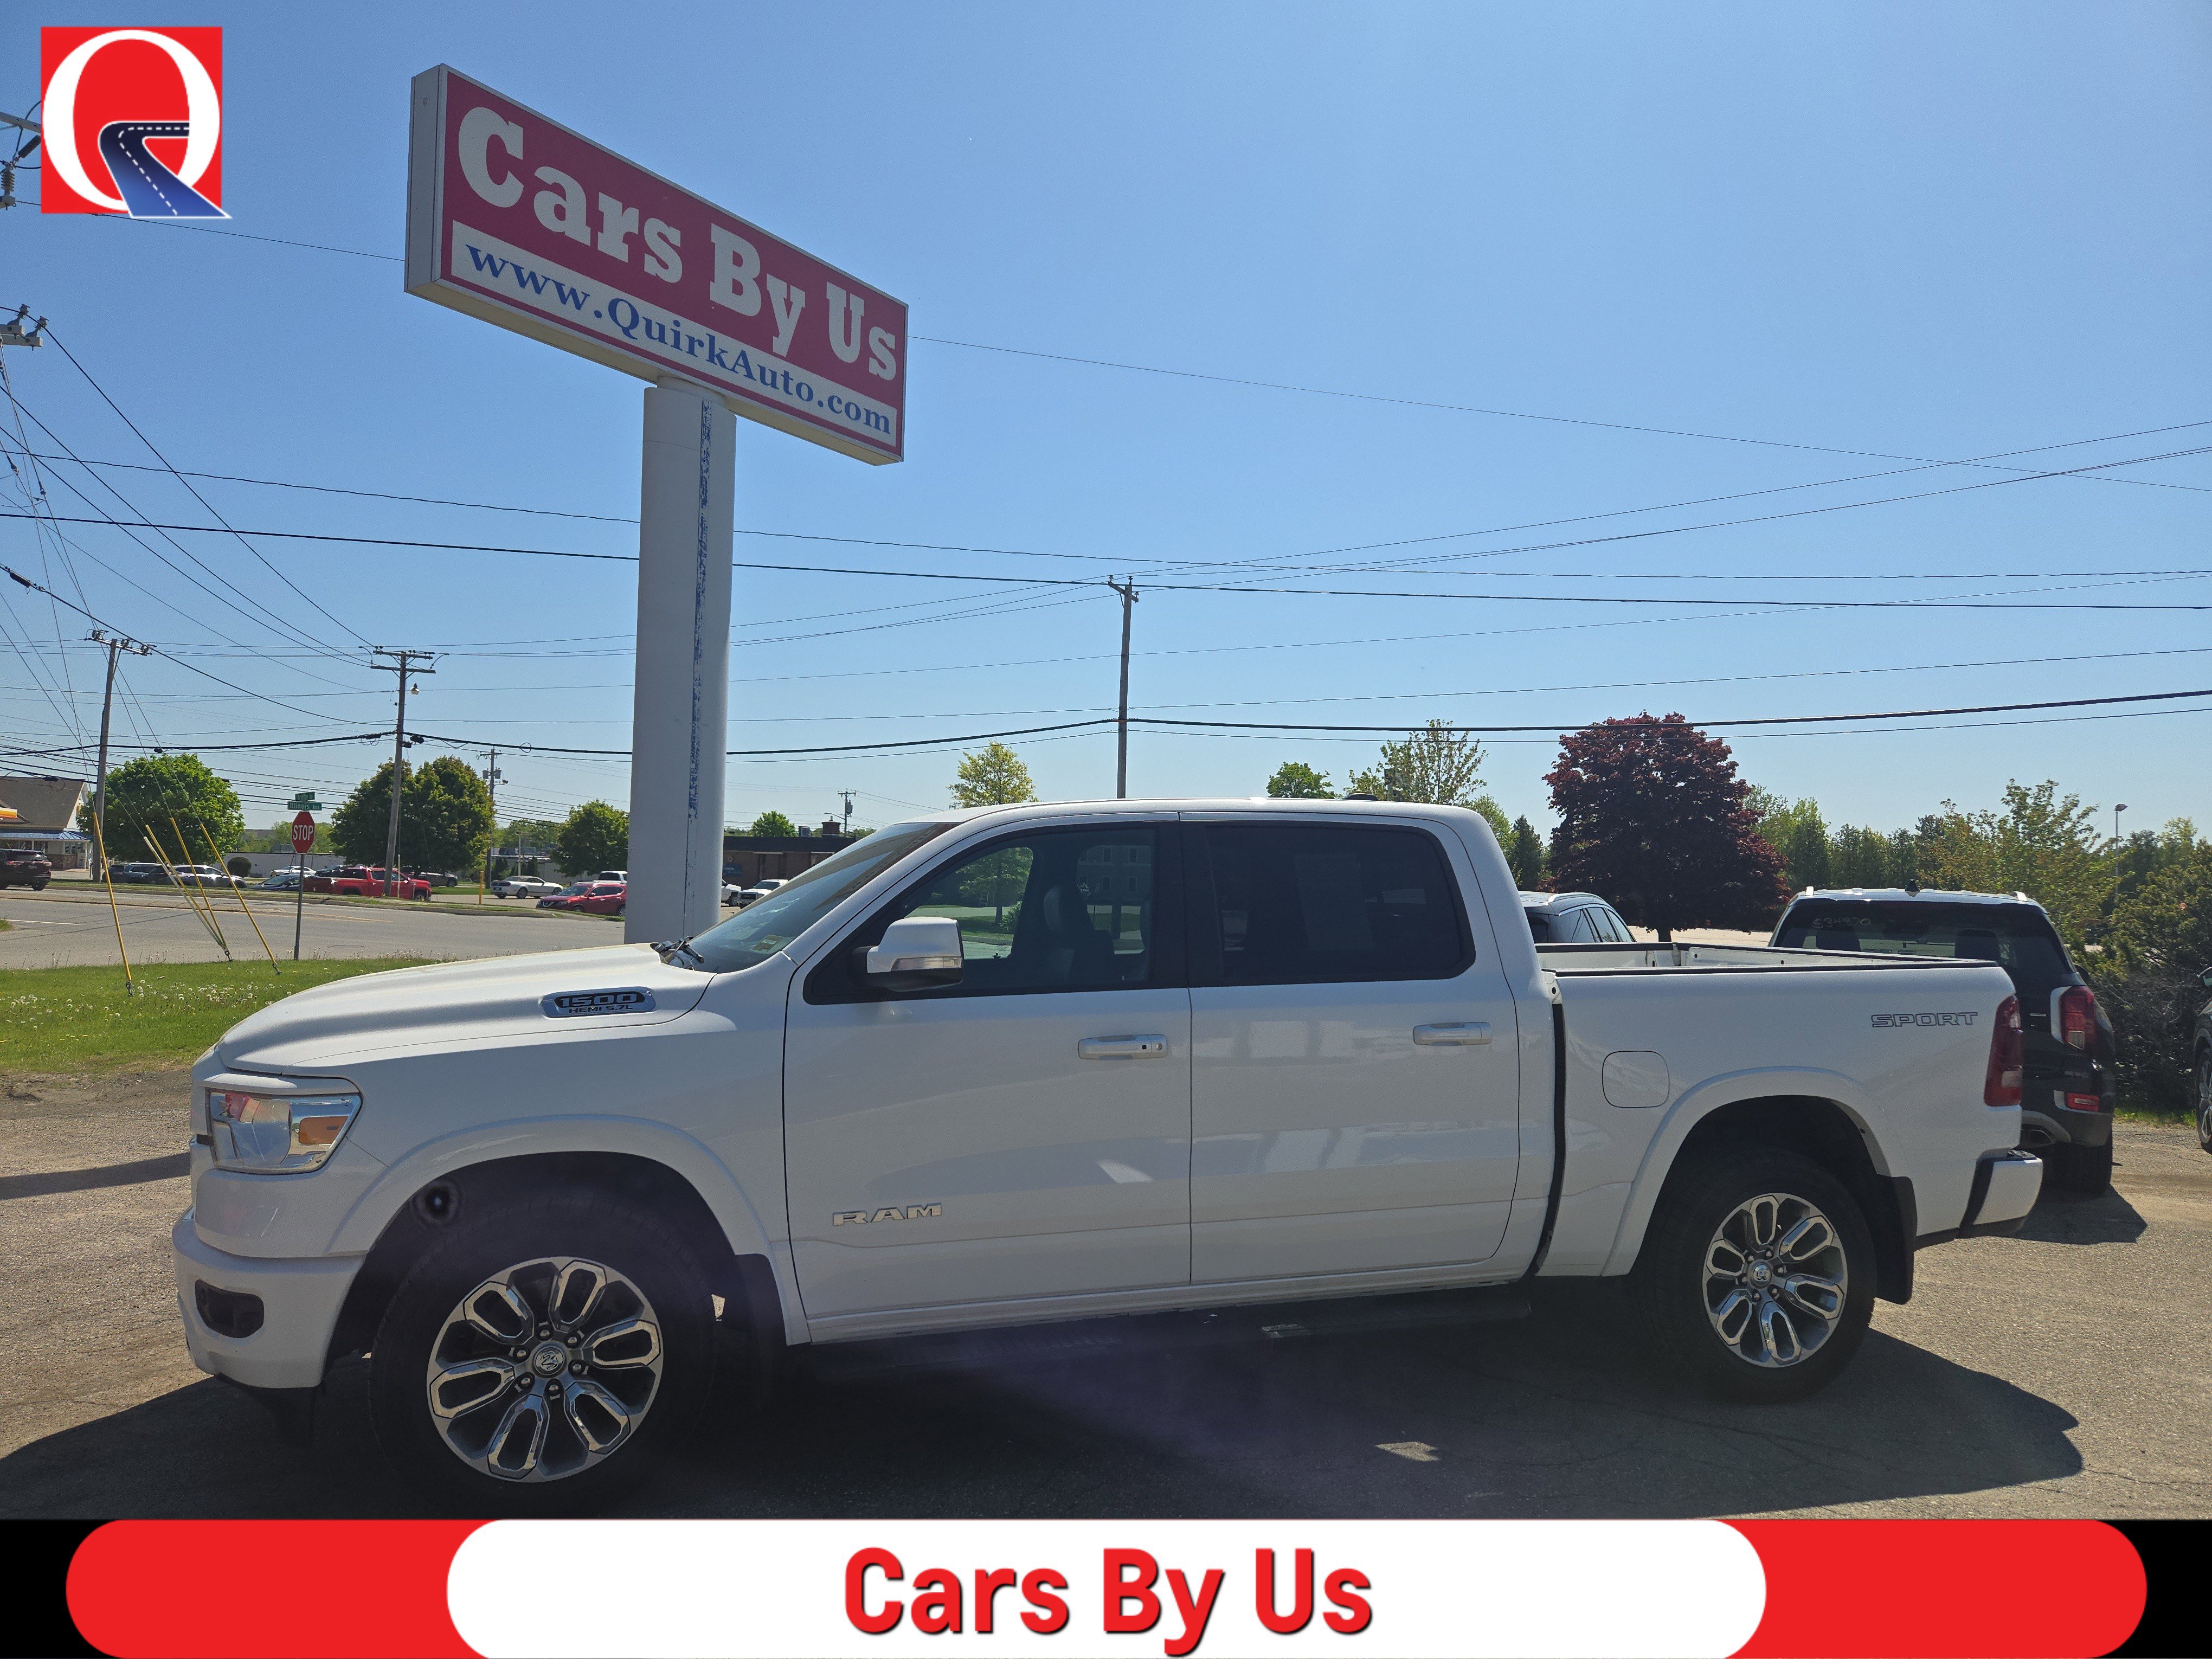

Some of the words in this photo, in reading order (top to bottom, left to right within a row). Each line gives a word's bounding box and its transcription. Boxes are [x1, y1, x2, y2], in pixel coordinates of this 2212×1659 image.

[459, 107, 683, 282] Cars
[710, 223, 805, 356] By
[826, 281, 896, 381] Us
[465, 244, 891, 434] www.QuirkAuto.com
[293, 825, 313, 840] STOP
[561, 994, 636, 1007] 1500
[1871, 1012, 1978, 1027] SPORT
[833, 1203, 942, 1226] RAM
